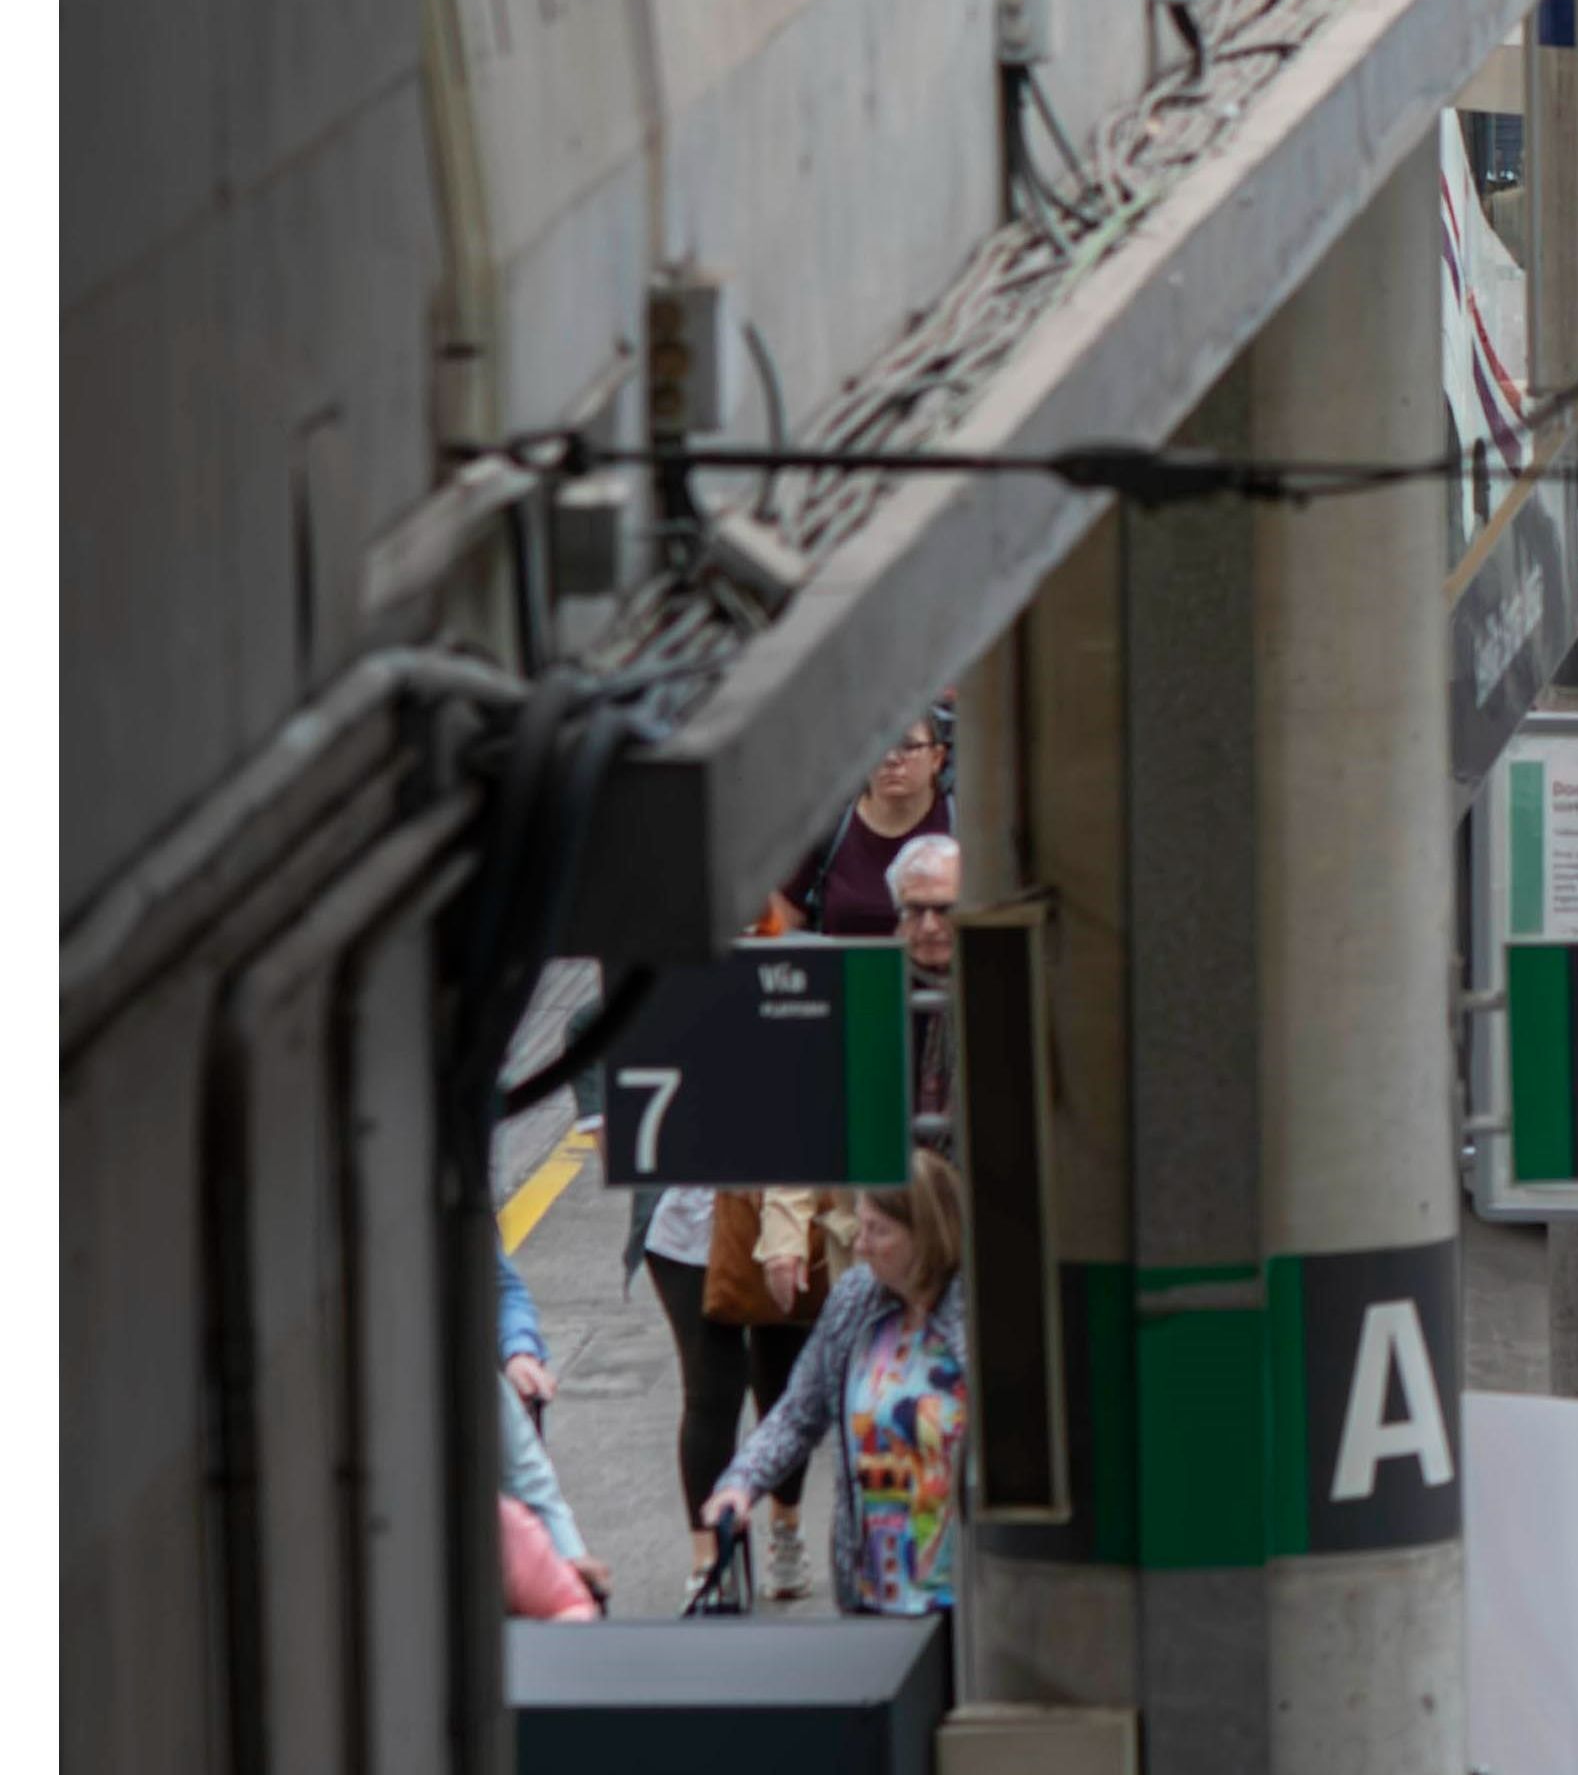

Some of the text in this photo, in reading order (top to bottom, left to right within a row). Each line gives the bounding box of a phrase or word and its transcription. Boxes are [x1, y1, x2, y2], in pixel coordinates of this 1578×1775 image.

[757, 961, 808, 994] Vía
[616, 1067, 682, 1174] 7
[1330, 1298, 1456, 1503] A
